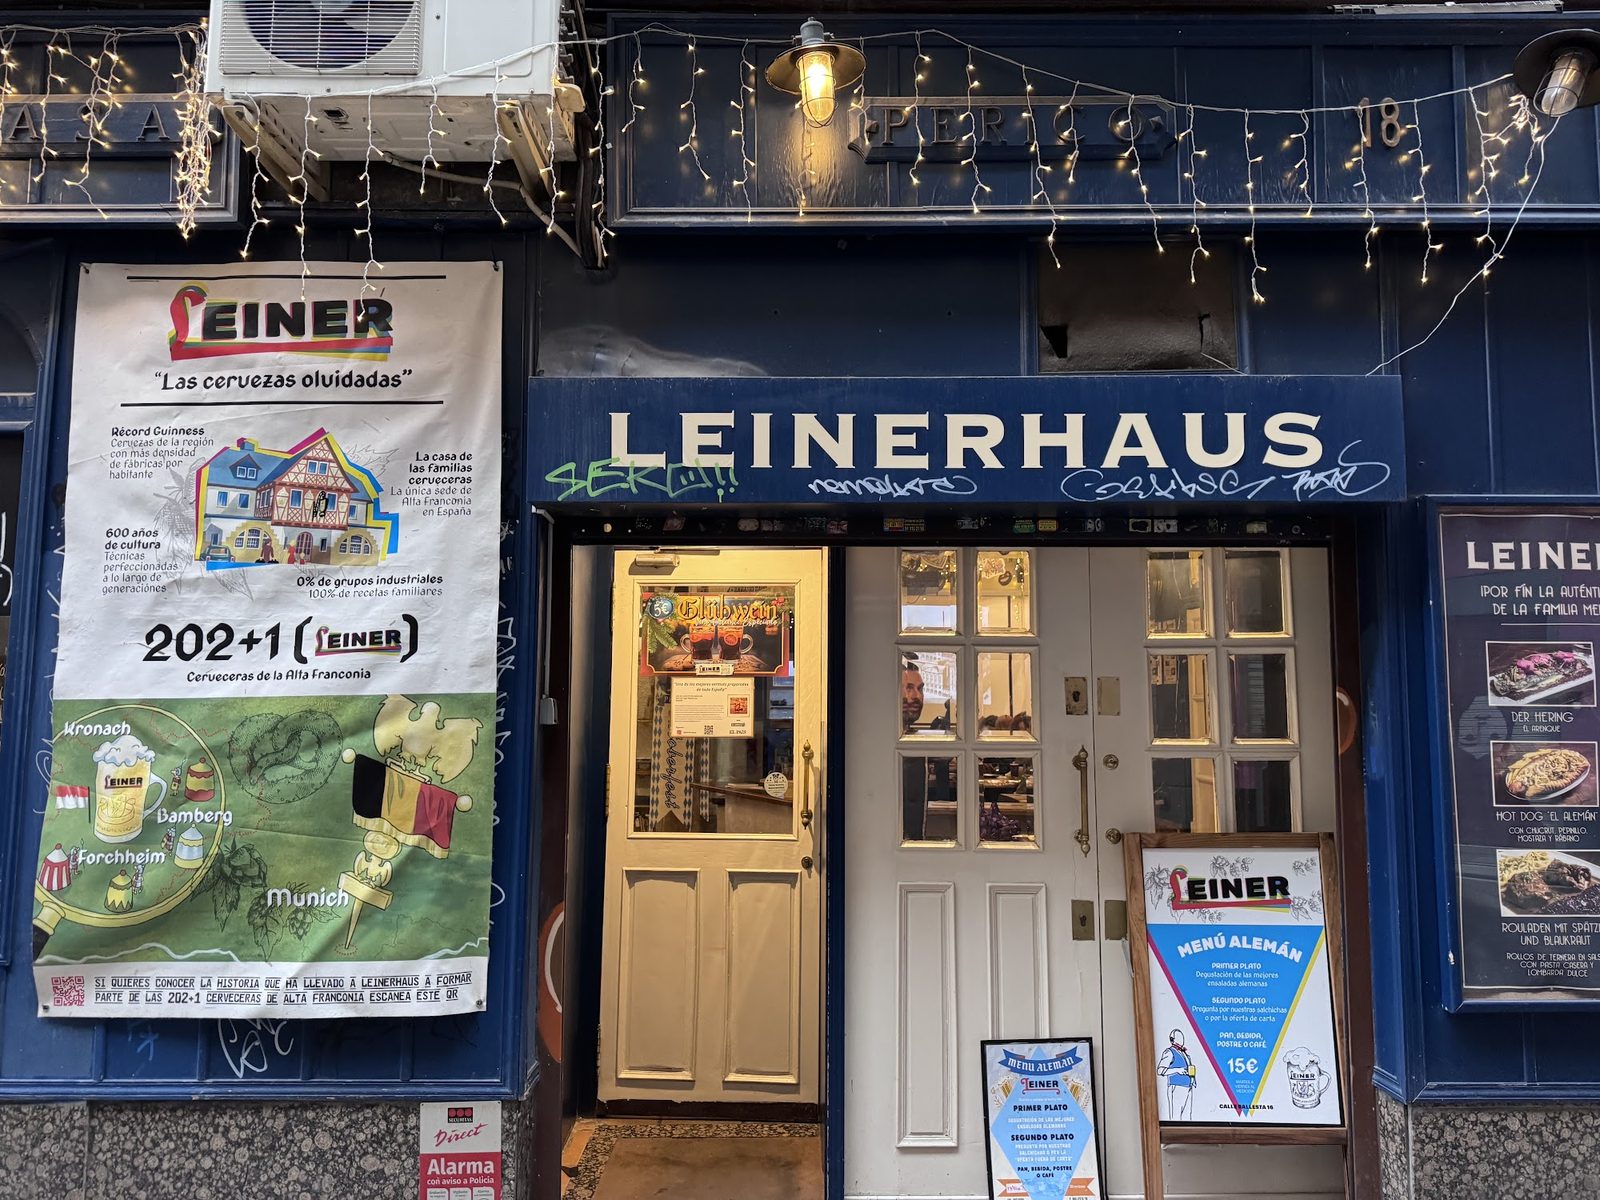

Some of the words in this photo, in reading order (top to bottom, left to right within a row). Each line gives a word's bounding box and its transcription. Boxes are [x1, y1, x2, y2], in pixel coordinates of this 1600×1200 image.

[882, 104, 1144, 145] PERICO
[1358, 97, 1401, 148] 18
[168, 282, 394, 361] LEINER
[112, 426, 150, 437] Récord
[153, 426, 205, 436] Guinness
[111, 437, 154, 447] Cervezas
[157, 437, 168, 447] de
[171, 437, 180, 446] la
[183, 437, 214, 448] región
[609, 408, 1324, 471] LEINERHAUS
[110, 449, 128, 458] con
[130, 447, 148, 457] más
[152, 447, 196, 458] densidad
[416, 452, 430, 461] La
[432, 452, 457, 461] casa
[460, 451, 472, 461] de
[109, 460, 121, 469] de
[124, 458, 163, 468] fábricas
[165, 459, 183, 469] por
[409, 463, 425, 473] las
[428, 462, 472, 473] familias
[109, 469, 153, 479] habitante
[408, 474, 472, 485] cerveceras
[391, 486, 402, 496] La
[405, 485, 431, 496] única
[434, 485, 458, 495] sede
[460, 486, 472, 495] de
[402, 496, 421, 506] Alta
[424, 495, 472, 506] Franconia
[422, 508, 435, 517] en
[437, 506, 472, 517] España
[106, 528, 129, 538] 600
[132, 528, 159, 538] años
[105, 540, 118, 550] de
[121, 539, 161, 549] cultura
[104, 551, 145, 561] Técnicas
[1466, 541, 1600, 570] LEINE
[111, 573, 120, 582] lo
[122, 573, 147, 583] largo
[150, 572, 162, 581] de
[297, 576, 315, 586] 0%
[318, 576, 332, 586] de
[334, 575, 374, 588] grupos
[376, 574, 443, 586] industriales
[309, 588, 336, 598] 100%
[339, 588, 350, 598] de
[353, 587, 389, 597] recetas
[392, 586, 443, 596] familiares
[1538, 585, 1553, 598] LA
[654, 602, 669, 616] 5€
[1493, 604, 1507, 616] DE
[1513, 603, 1528, 616] LA
[1534, 603, 1578, 616] FAMILIA
[142, 622, 281, 661] 202+1
[187, 670, 254, 683] Cerveceras
[257, 670, 270, 681] de
[273, 669, 283, 681] la
[286, 668, 309, 681] Alta
[311, 668, 371, 681] Franconia
[1511, 712, 1530, 722] DER
[1534, 711, 1574, 723] HERING
[1532, 725, 1560, 734] ARENQUE
[104, 775, 143, 790] LEINER
[157, 807, 233, 826] Bamberg
[1496, 811, 1516, 822] HOT
[1520, 811, 1544, 822] DOG
[77, 849, 166, 865] Forchheim
[1170, 864, 1291, 913] LEINER
[1501, 922, 1551, 934] ROULADEN
[1554, 922, 1568, 933] MIT
[1520, 935, 1539, 946] UND
[1544, 935, 1591, 946] BLAUKRAUT
[1176, 931, 1226, 959] MENÚ
[1229, 934, 1303, 963] ALEMÁN
[1506, 952, 1534, 961] ROLLOS
[1537, 953, 1546, 961] DE
[1549, 953, 1576, 962] TERNERA
[1578, 953, 1586, 961] EN
[1211, 962, 1239, 970] PRIMER
[1240, 962, 1262, 970] PLATO
[1540, 961, 1560, 969] PASTA
[1196, 971, 1233, 980] Degustación
[1253, 971, 1279, 980] mejores
[1567, 969, 1588, 977] DULCE
[94, 978, 106, 988] SI
[111, 978, 150, 989] QUIERES
[155, 978, 195, 989] CONOCER
[200, 978, 212, 989] LA
[217, 978, 260, 989] HISTORIA
[264, 978, 280, 990] QUE
[285, 978, 298, 990] HA
[303, 977, 344, 989] LLEVADO
[361, 975, 420, 988] LEINERHAUS
[436, 972, 472, 985] FORMAR
[95, 992, 123, 1003] PARTE
[128, 992, 140, 1003] DE
[145, 992, 163, 1003] LAS
[168, 992, 201, 1004] 202+1
[206, 992, 261, 1004] CERVECERAS
[266, 992, 278, 1003] DE
[283, 992, 307, 1003] ALTA
[312, 991, 364, 1003] FRANCONIA
[369, 990, 411, 1002] ESCANEA
[416, 989, 440, 1001] ESTE
[446, 988, 458, 1000] QR
[1192, 1005, 1218, 1014] Pregunta
[1220, 1006, 1230, 1014] por
[1256, 1005, 1288, 1014] salchichas
[1210, 1014, 1221, 1022] por
[1230, 1014, 1249, 1022] oferta
[1216, 1040, 1243, 1048] POSTRE
[1250, 1040, 1267, 1048] CAFÉ
[1008, 1057, 1035, 1071] MENU
[1036, 1056, 1074, 1071] ALEMAN
[1227, 1058, 1258, 1074] 15€
[1021, 1078, 1061, 1095] LEINER
[434, 1123, 488, 1147] Direct
[427, 1158, 494, 1175] Alarma
[427, 1177, 440, 1185] con
